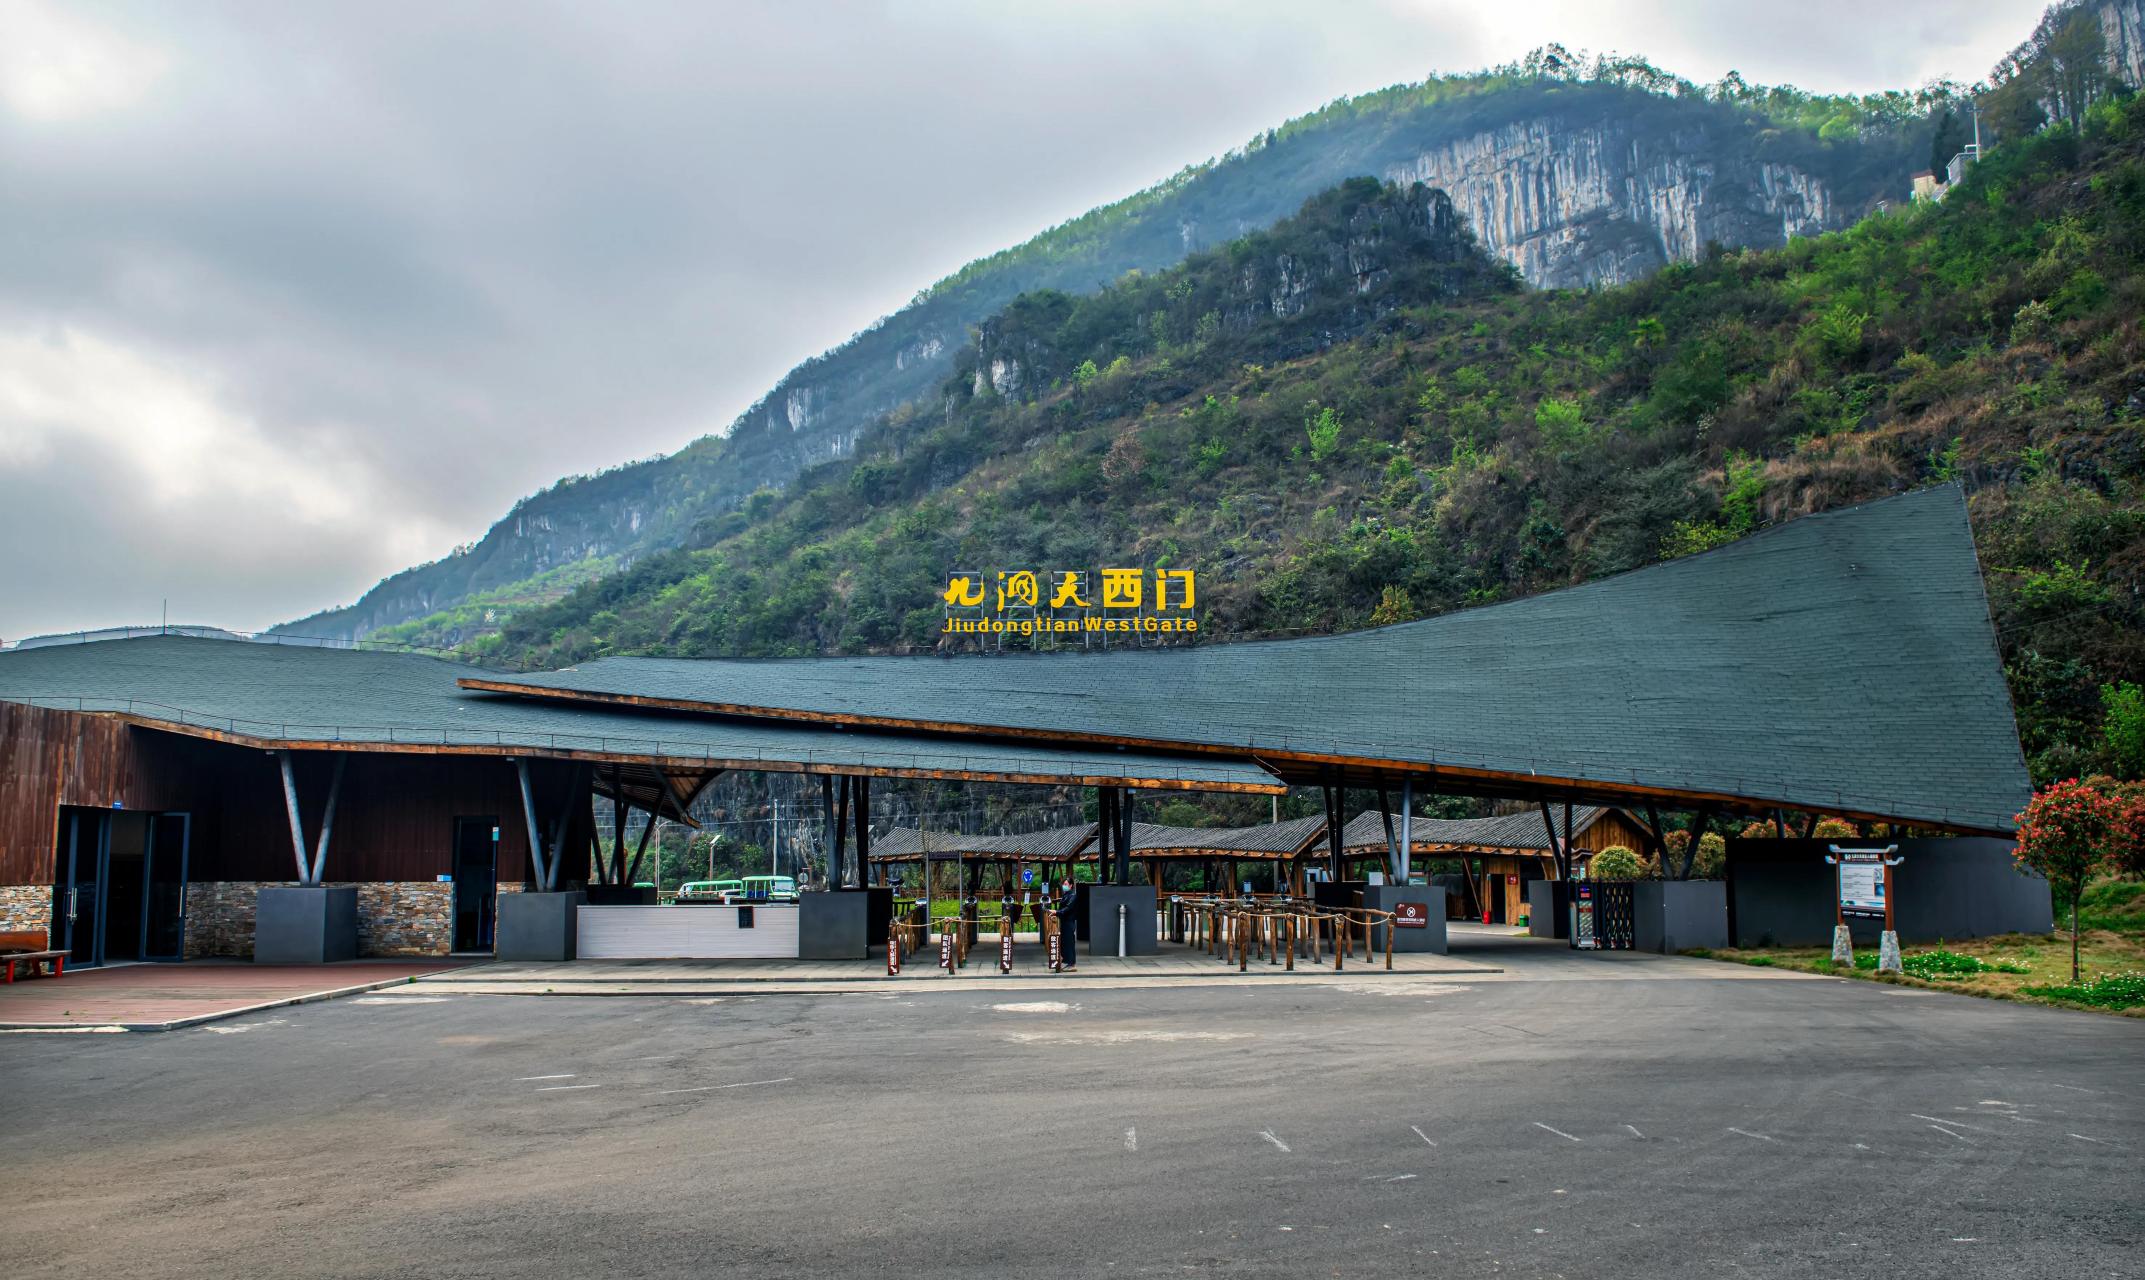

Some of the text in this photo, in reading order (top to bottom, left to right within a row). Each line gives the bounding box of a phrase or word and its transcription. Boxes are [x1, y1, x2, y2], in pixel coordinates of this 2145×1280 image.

[943, 568, 1196, 612] 九洞天西门
[942, 616, 1079, 636] Jiudongtian
